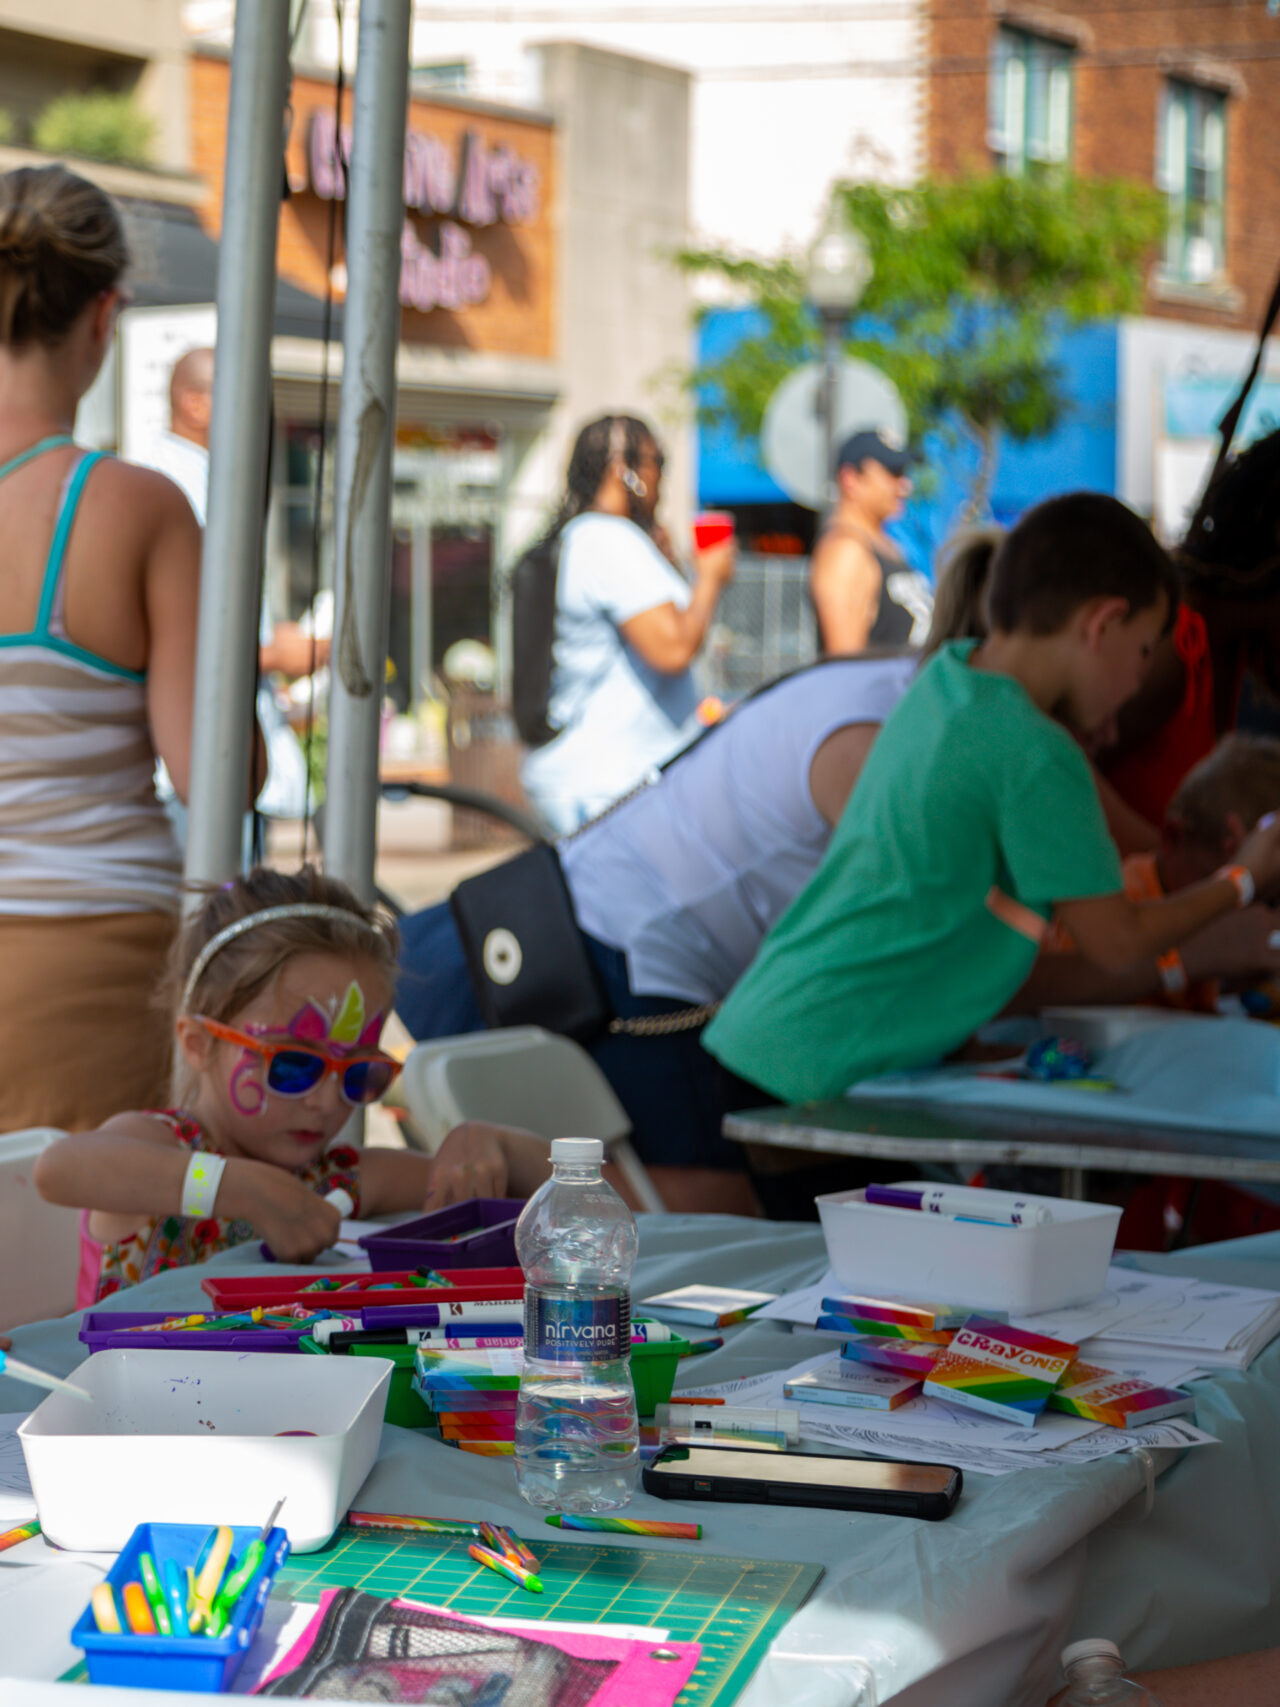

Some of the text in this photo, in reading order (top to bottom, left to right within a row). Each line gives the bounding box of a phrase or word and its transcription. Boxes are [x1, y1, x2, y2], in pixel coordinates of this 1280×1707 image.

[545, 1322, 616, 1339] nirvana
[545, 1339, 616, 1348] POSITIVELY PURE
